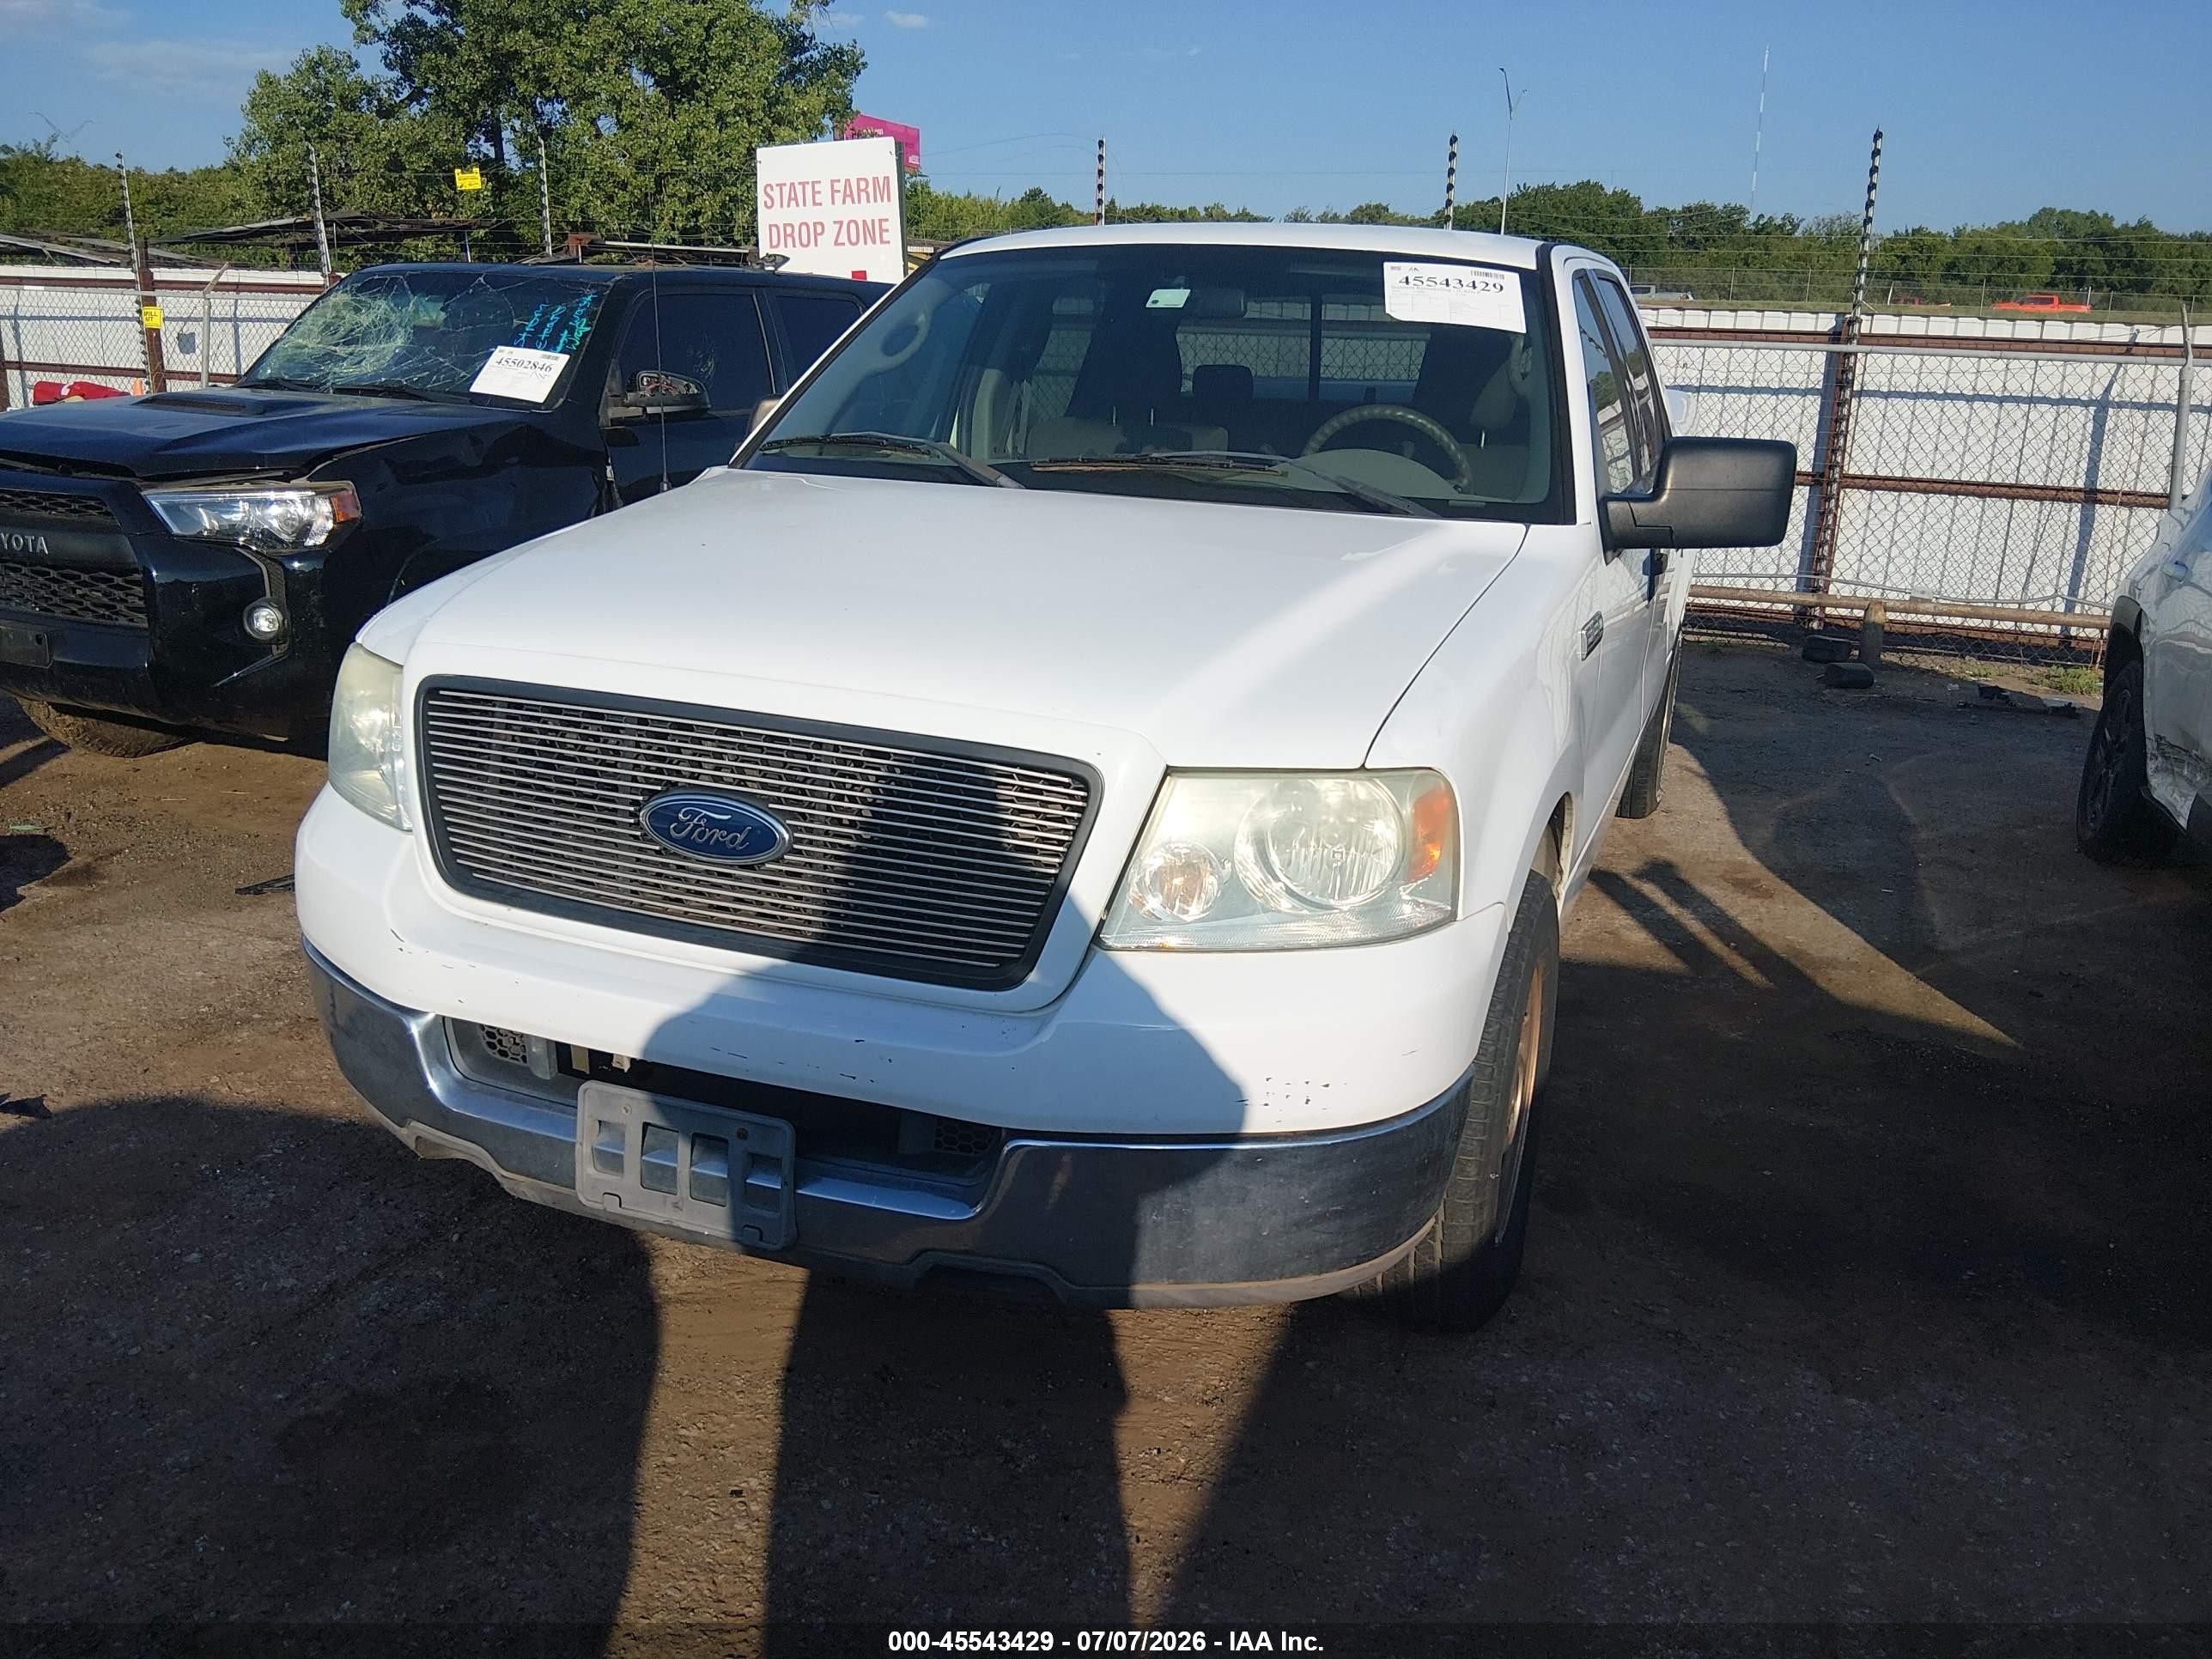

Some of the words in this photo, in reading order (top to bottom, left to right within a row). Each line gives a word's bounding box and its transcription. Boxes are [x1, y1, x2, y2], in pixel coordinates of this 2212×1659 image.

[763, 180, 823, 210] STATE
[830, 175, 892, 206] FARM
[768, 221, 825, 249] DROP
[833, 217, 891, 247] ZONE
[1398, 275, 1504, 294] 45543429
[495, 356, 555, 373] 45502846
[670, 806, 752, 851] Ford
